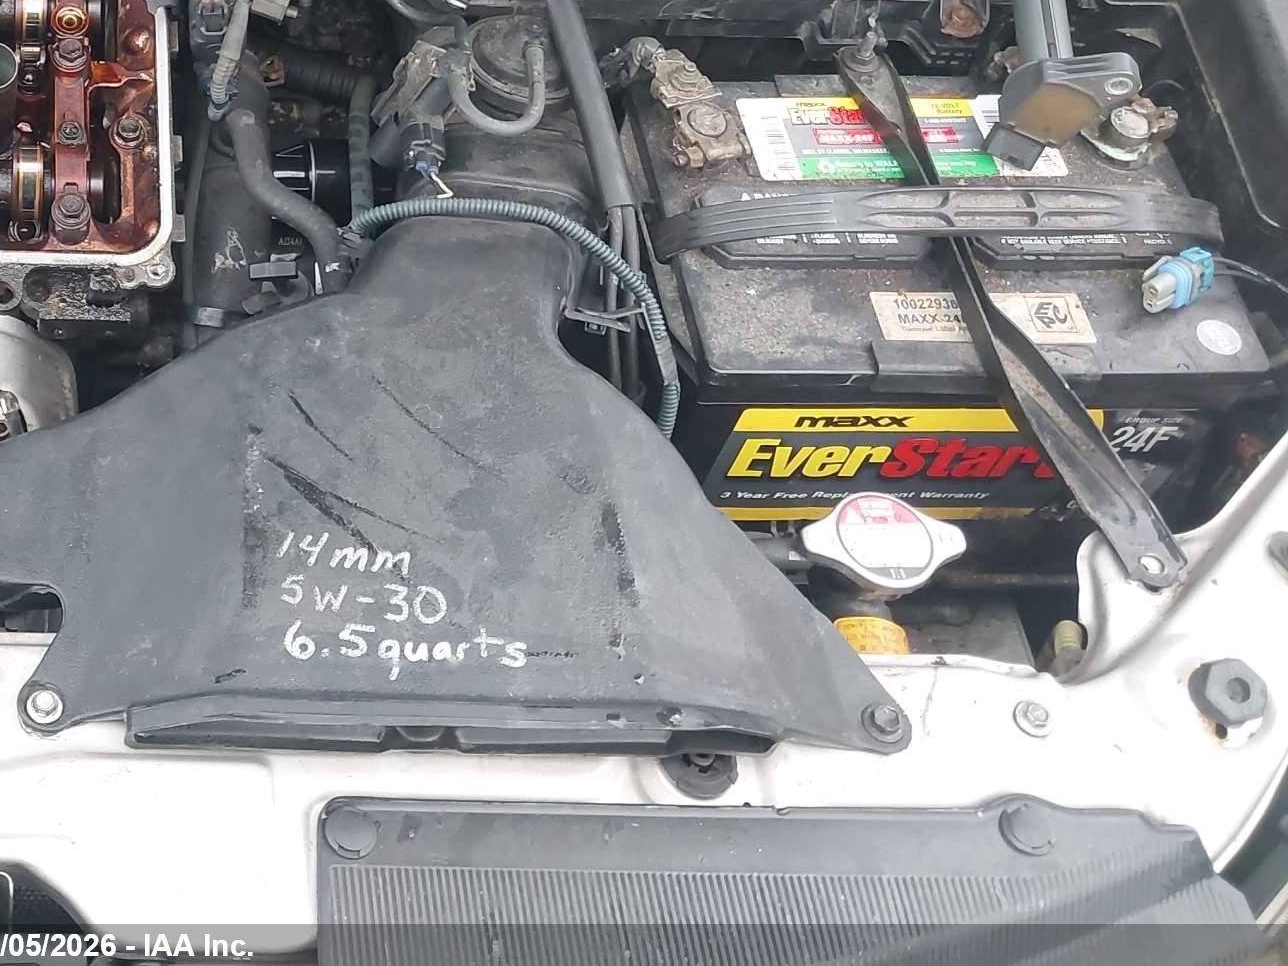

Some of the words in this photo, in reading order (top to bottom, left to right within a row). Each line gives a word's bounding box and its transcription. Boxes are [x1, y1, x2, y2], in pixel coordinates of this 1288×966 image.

[787, 107, 866, 126] EverSta
[897, 313, 961, 324] MAXX-24
[794, 415, 915, 428] maxx
[1110, 425, 1180, 453] 24F
[719, 491, 730, 499] 3
[736, 491, 769, 500] Year
[773, 491, 808, 500] Free
[919, 491, 990, 500] Warranty
